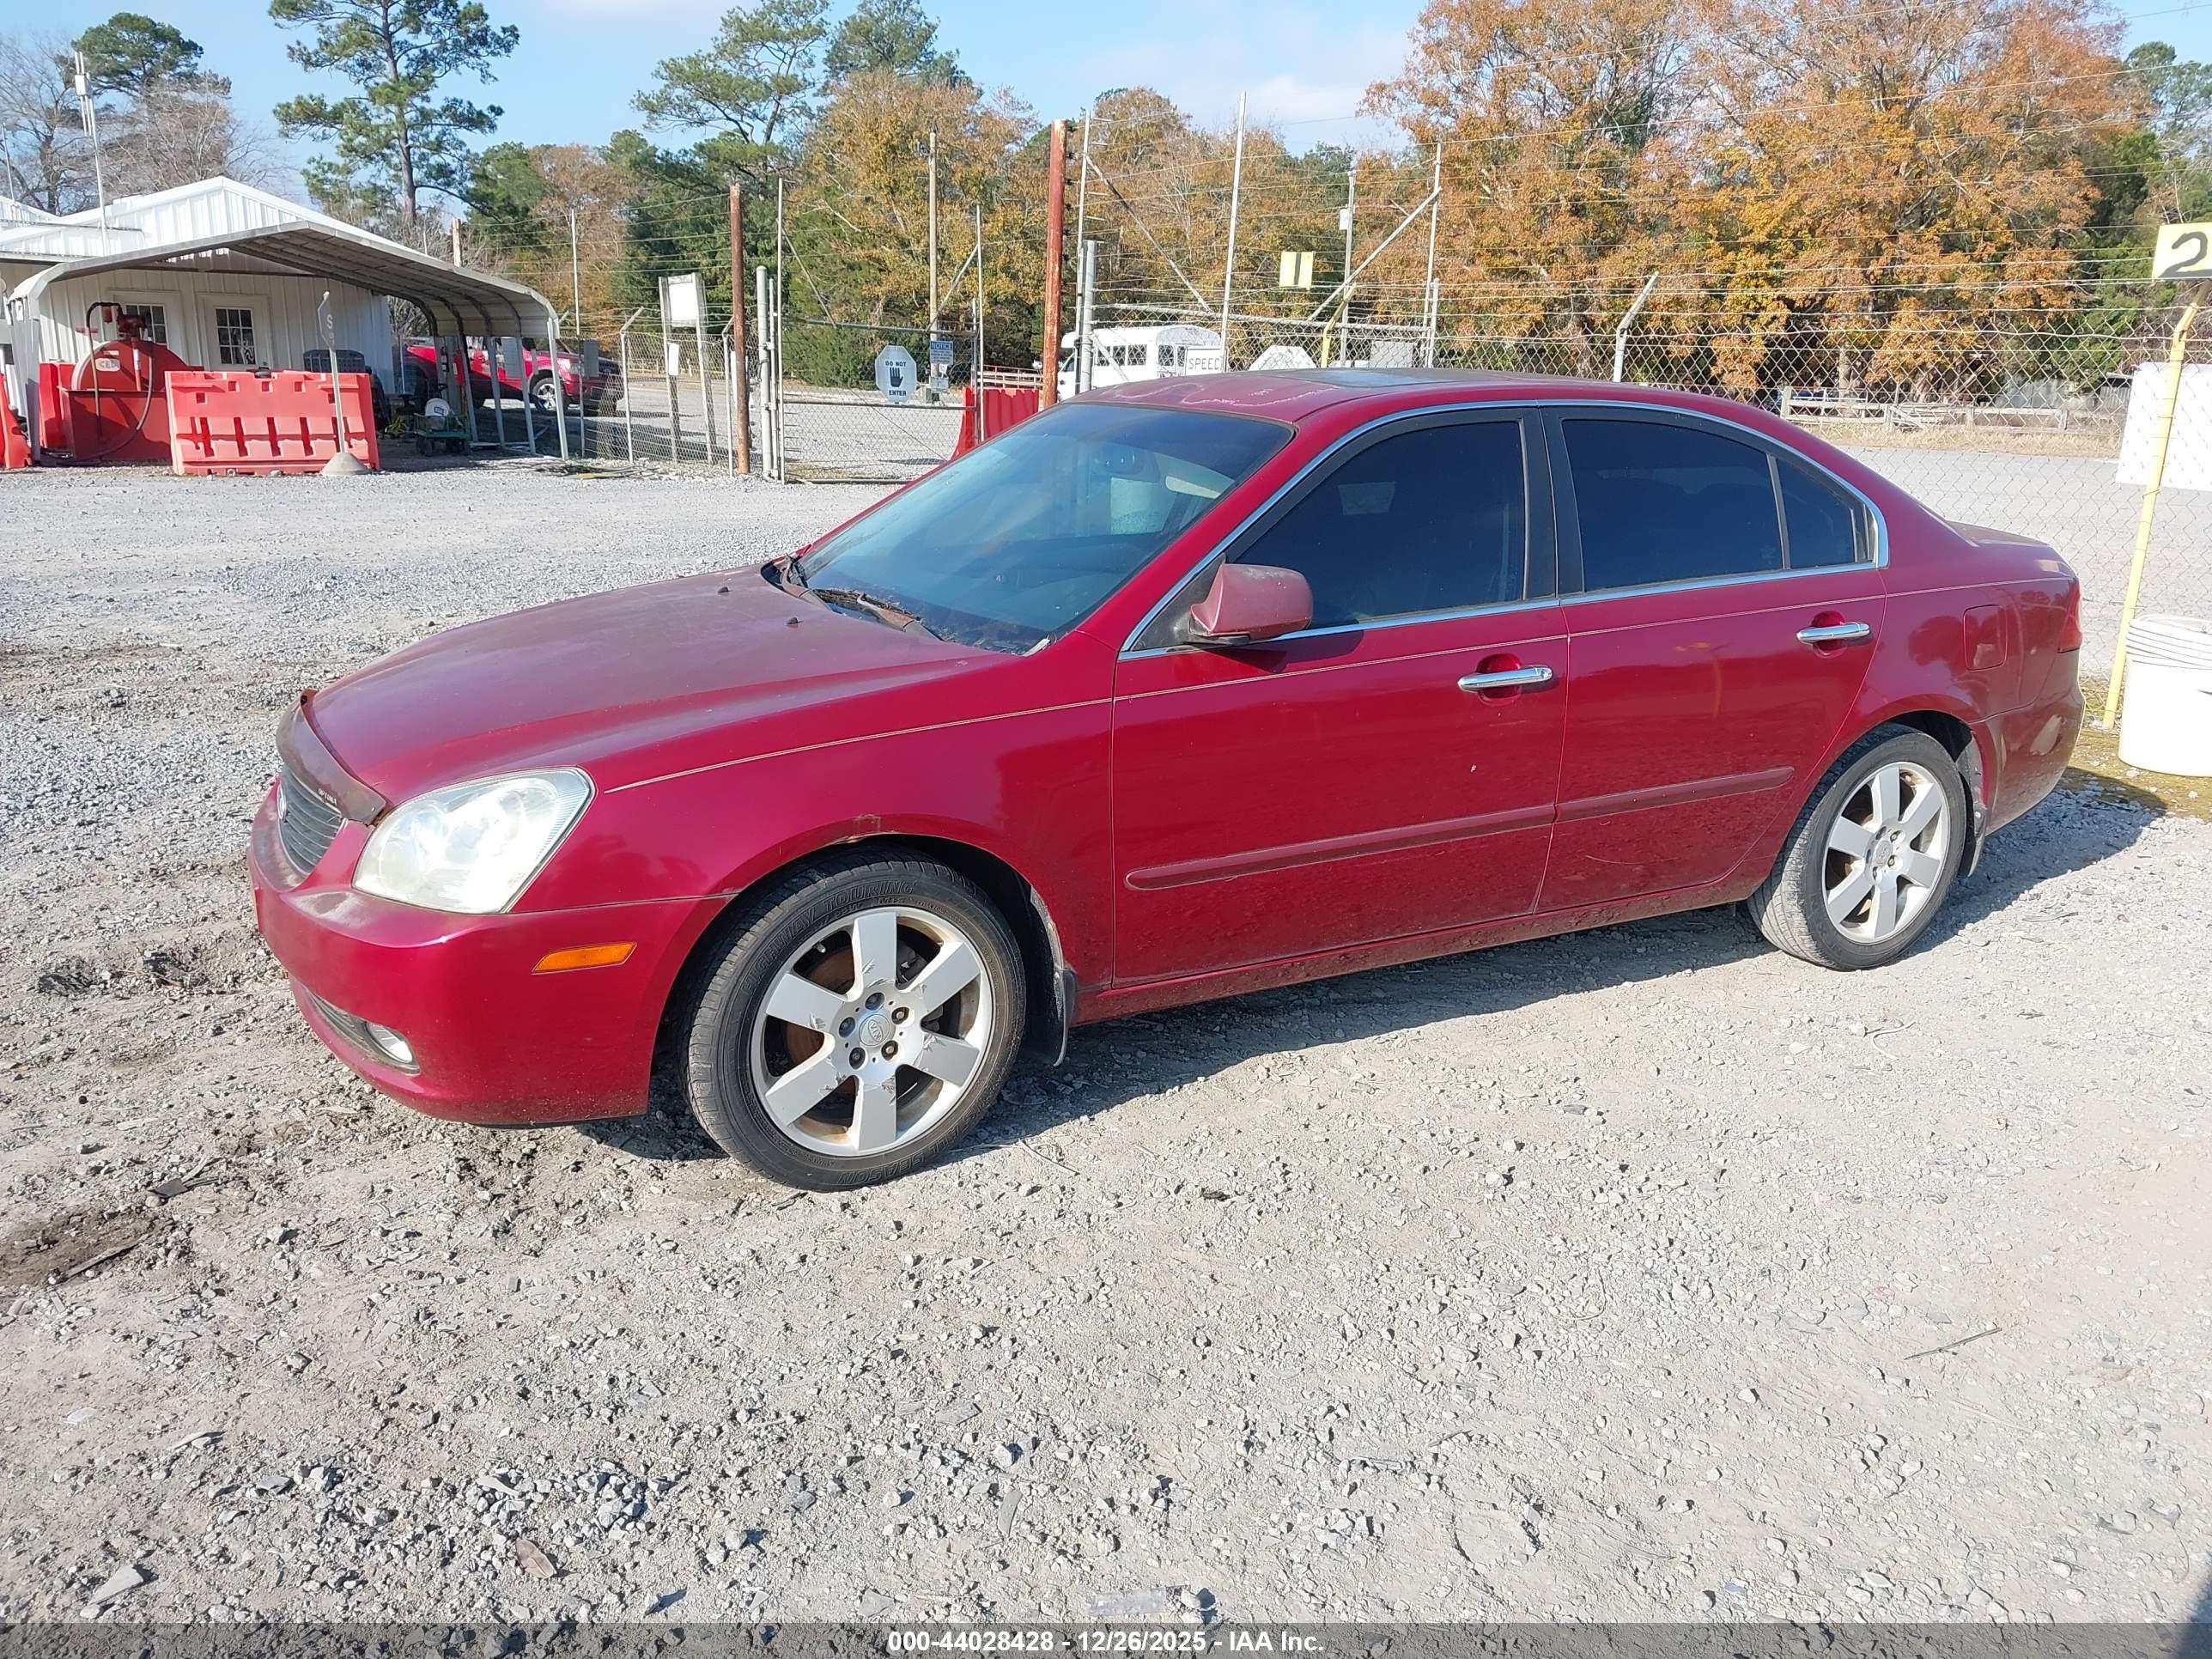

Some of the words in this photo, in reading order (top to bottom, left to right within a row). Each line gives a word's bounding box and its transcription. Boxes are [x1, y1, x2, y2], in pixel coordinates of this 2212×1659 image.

[2158, 231, 2212, 277] 2
[1188, 357, 1220, 370] SPEED
[742, 906, 817, 990] HIGHWAY
[823, 878, 915, 913] TOURING
[870, 1021, 882, 1040] KIA
[837, 1152, 926, 1185] SEASON
